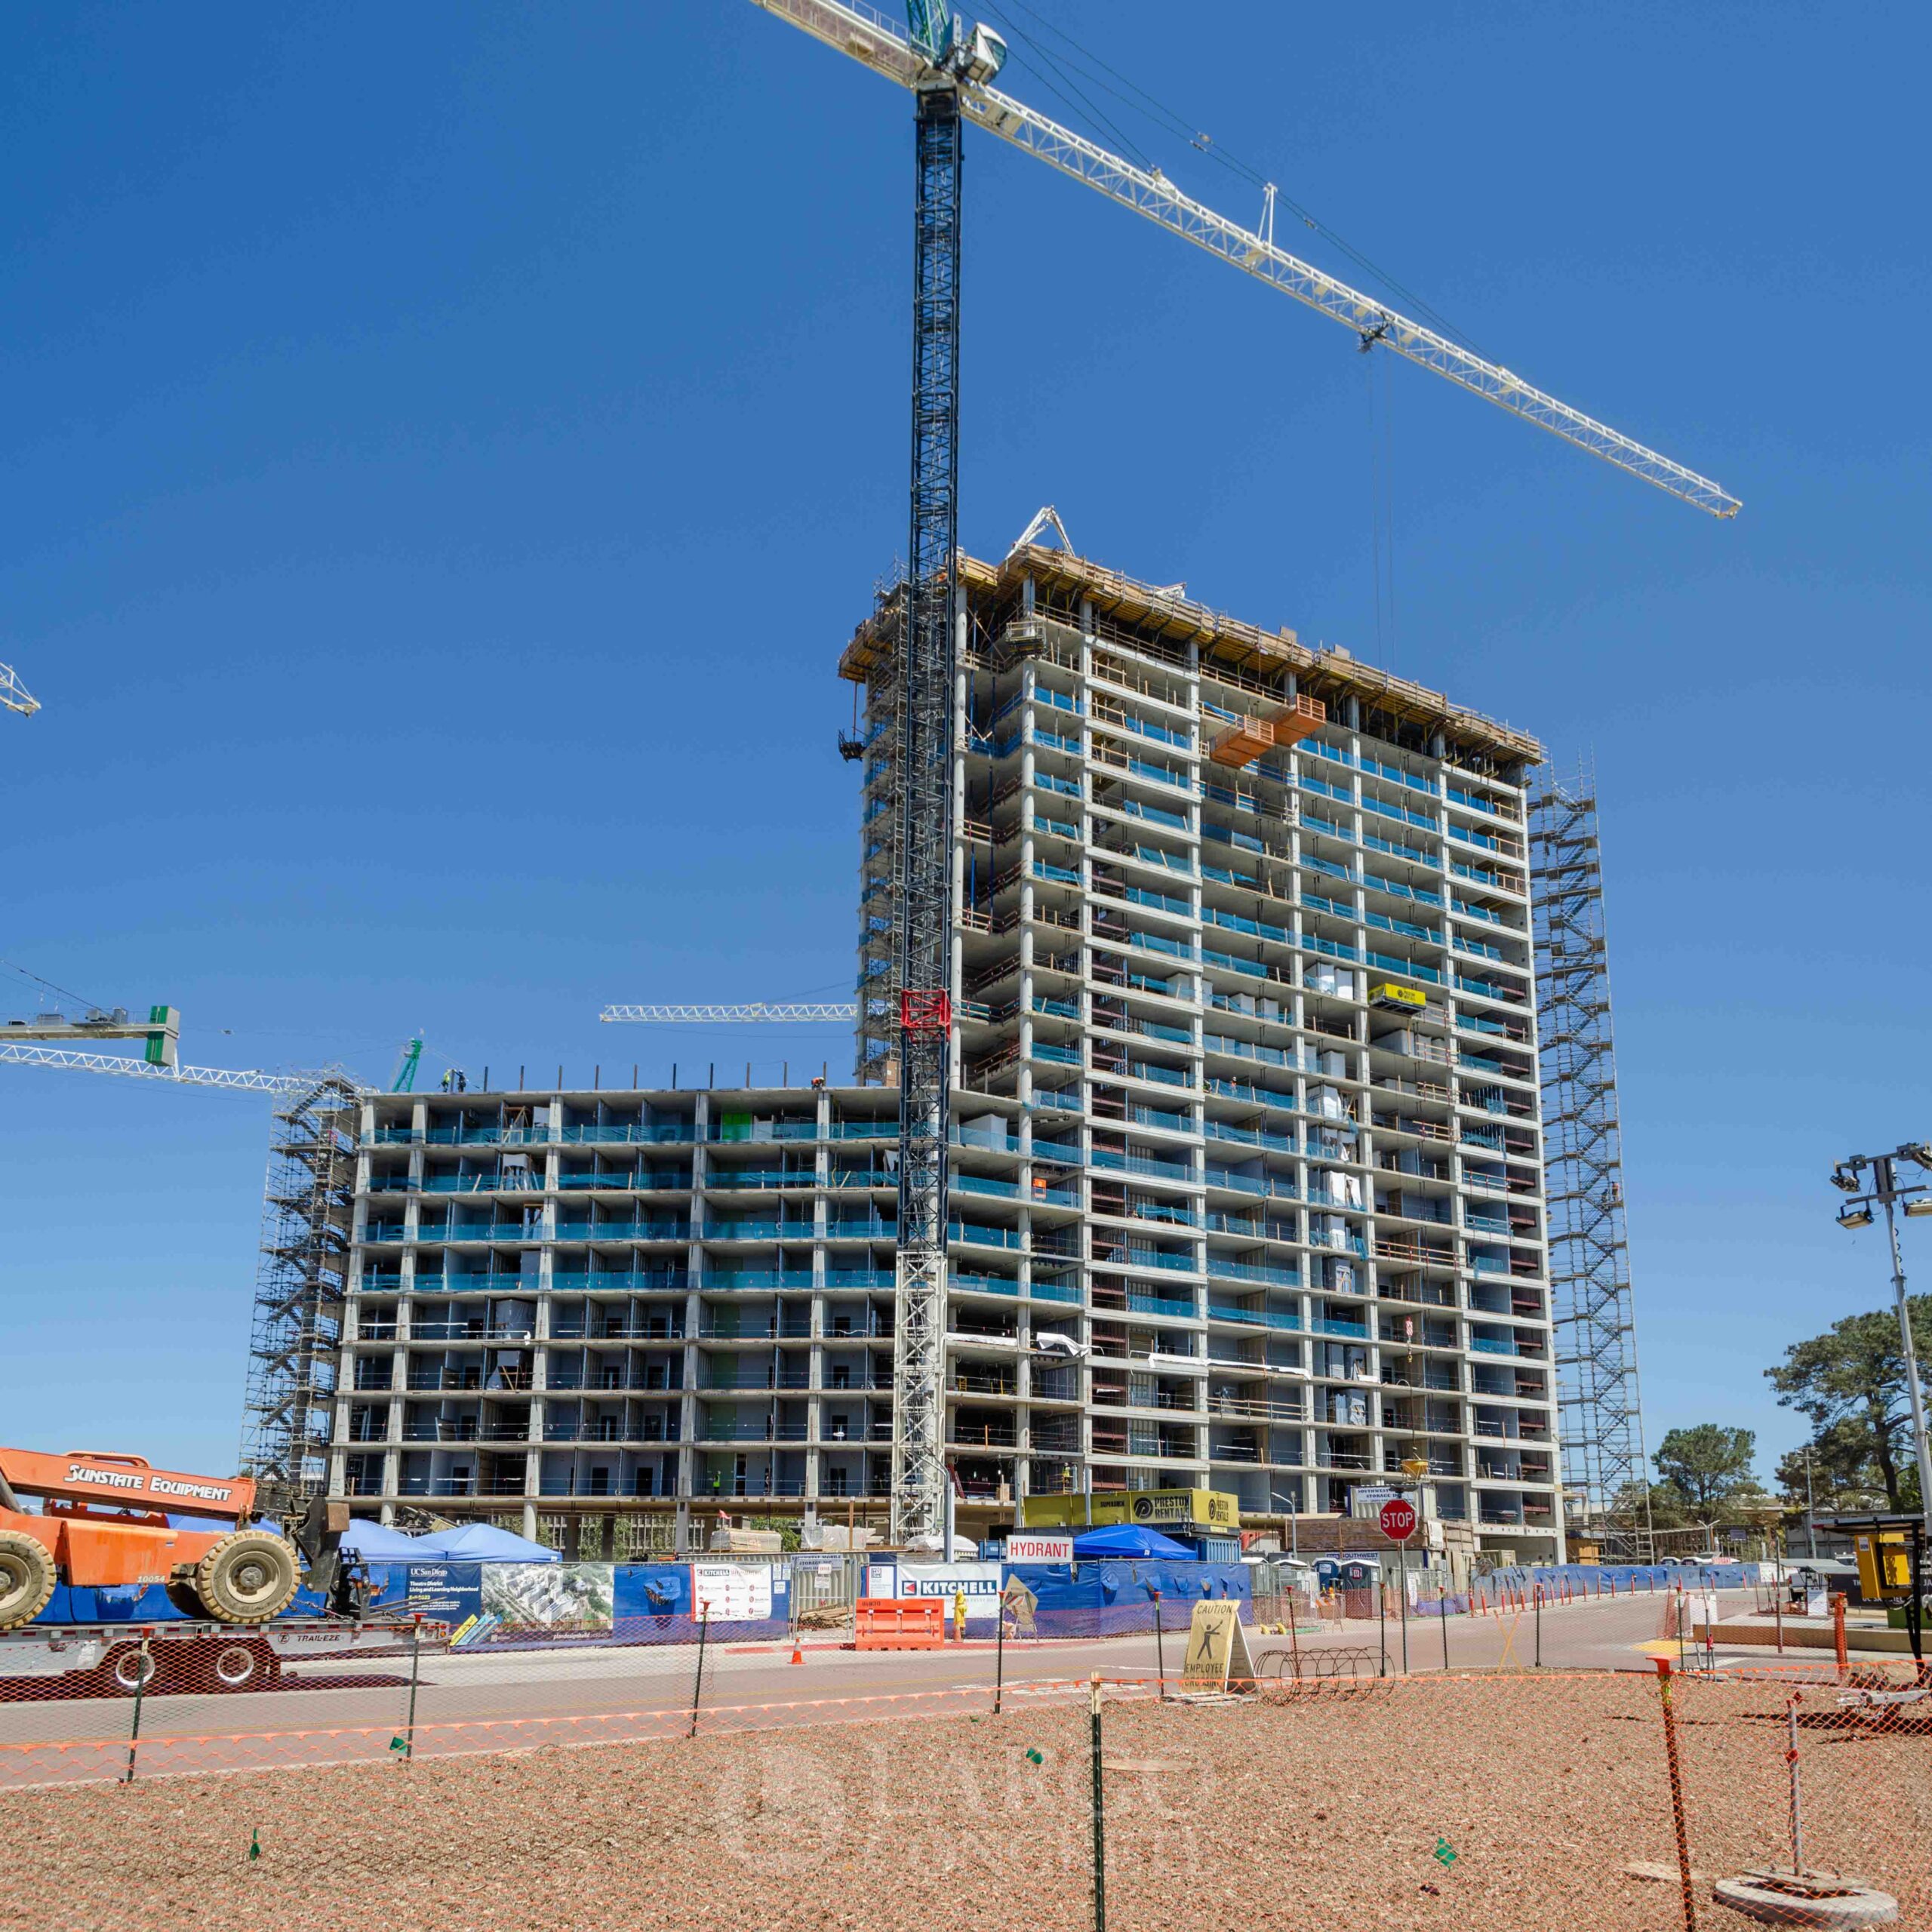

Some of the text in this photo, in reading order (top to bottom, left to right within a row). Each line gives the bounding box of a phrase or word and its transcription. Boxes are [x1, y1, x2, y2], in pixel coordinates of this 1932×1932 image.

[63, 1464, 232, 1501] SUNSTATE EQUIPMENT
[1154, 1495, 1189, 1508] PRESTON
[1382, 1512, 1413, 1528] STOP
[1011, 1542, 1069, 1558] HYDRANT
[432, 1568, 448, 1577] Diego
[137, 1575, 166, 1583] 10054
[922, 1582, 995, 1594] KITCHELL
[1197, 1604, 1233, 1614] CAUTION
[1185, 1663, 1224, 1673] EMPLOYEE
